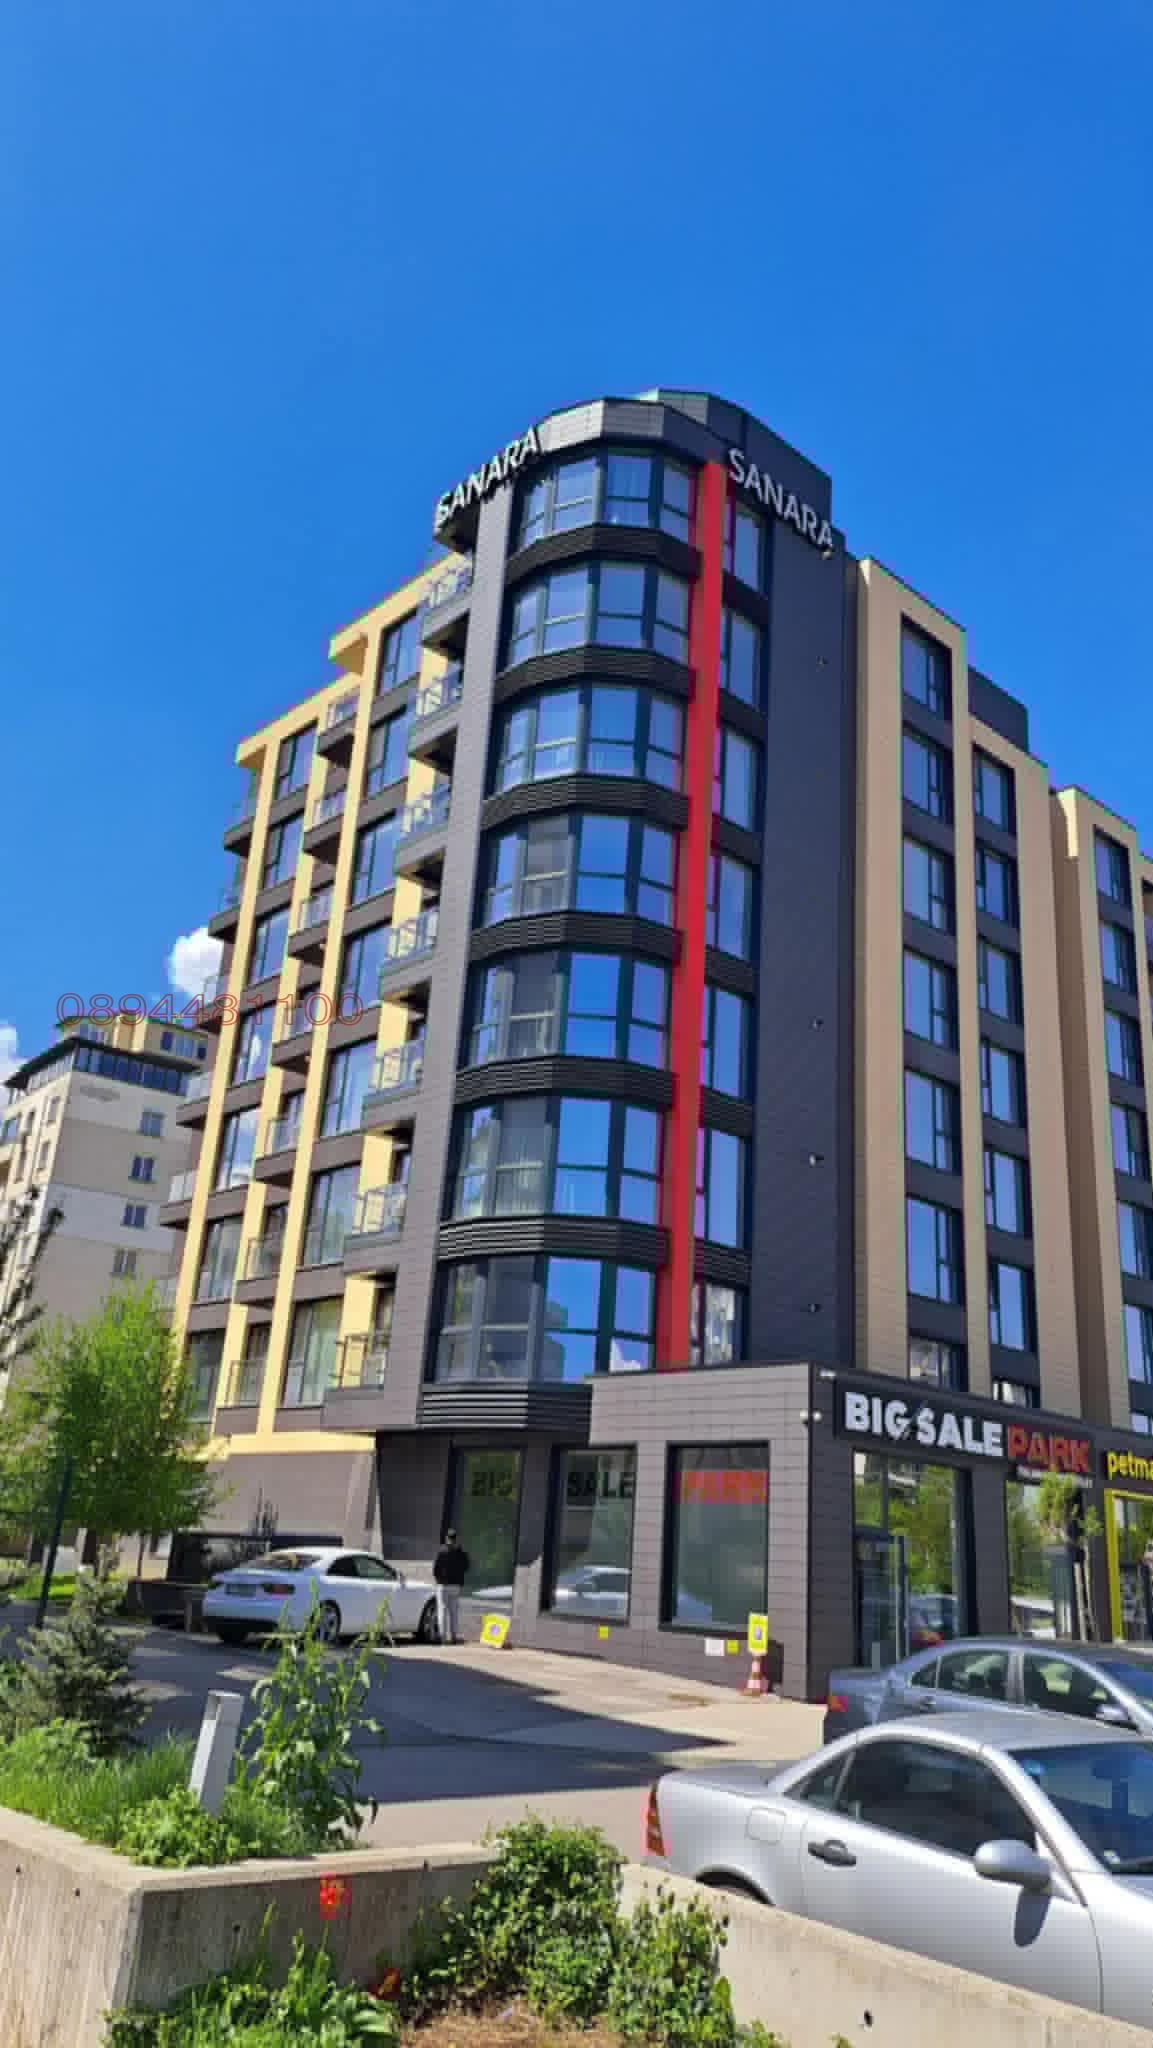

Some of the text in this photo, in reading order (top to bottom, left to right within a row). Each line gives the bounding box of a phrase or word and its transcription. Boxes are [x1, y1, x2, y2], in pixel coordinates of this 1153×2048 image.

[434, 425, 539, 532] SANARA
[728, 448, 833, 547] SANARA
[845, 1391, 1089, 1473] BIG SALE PARK
[567, 1470, 635, 1498] SALE
